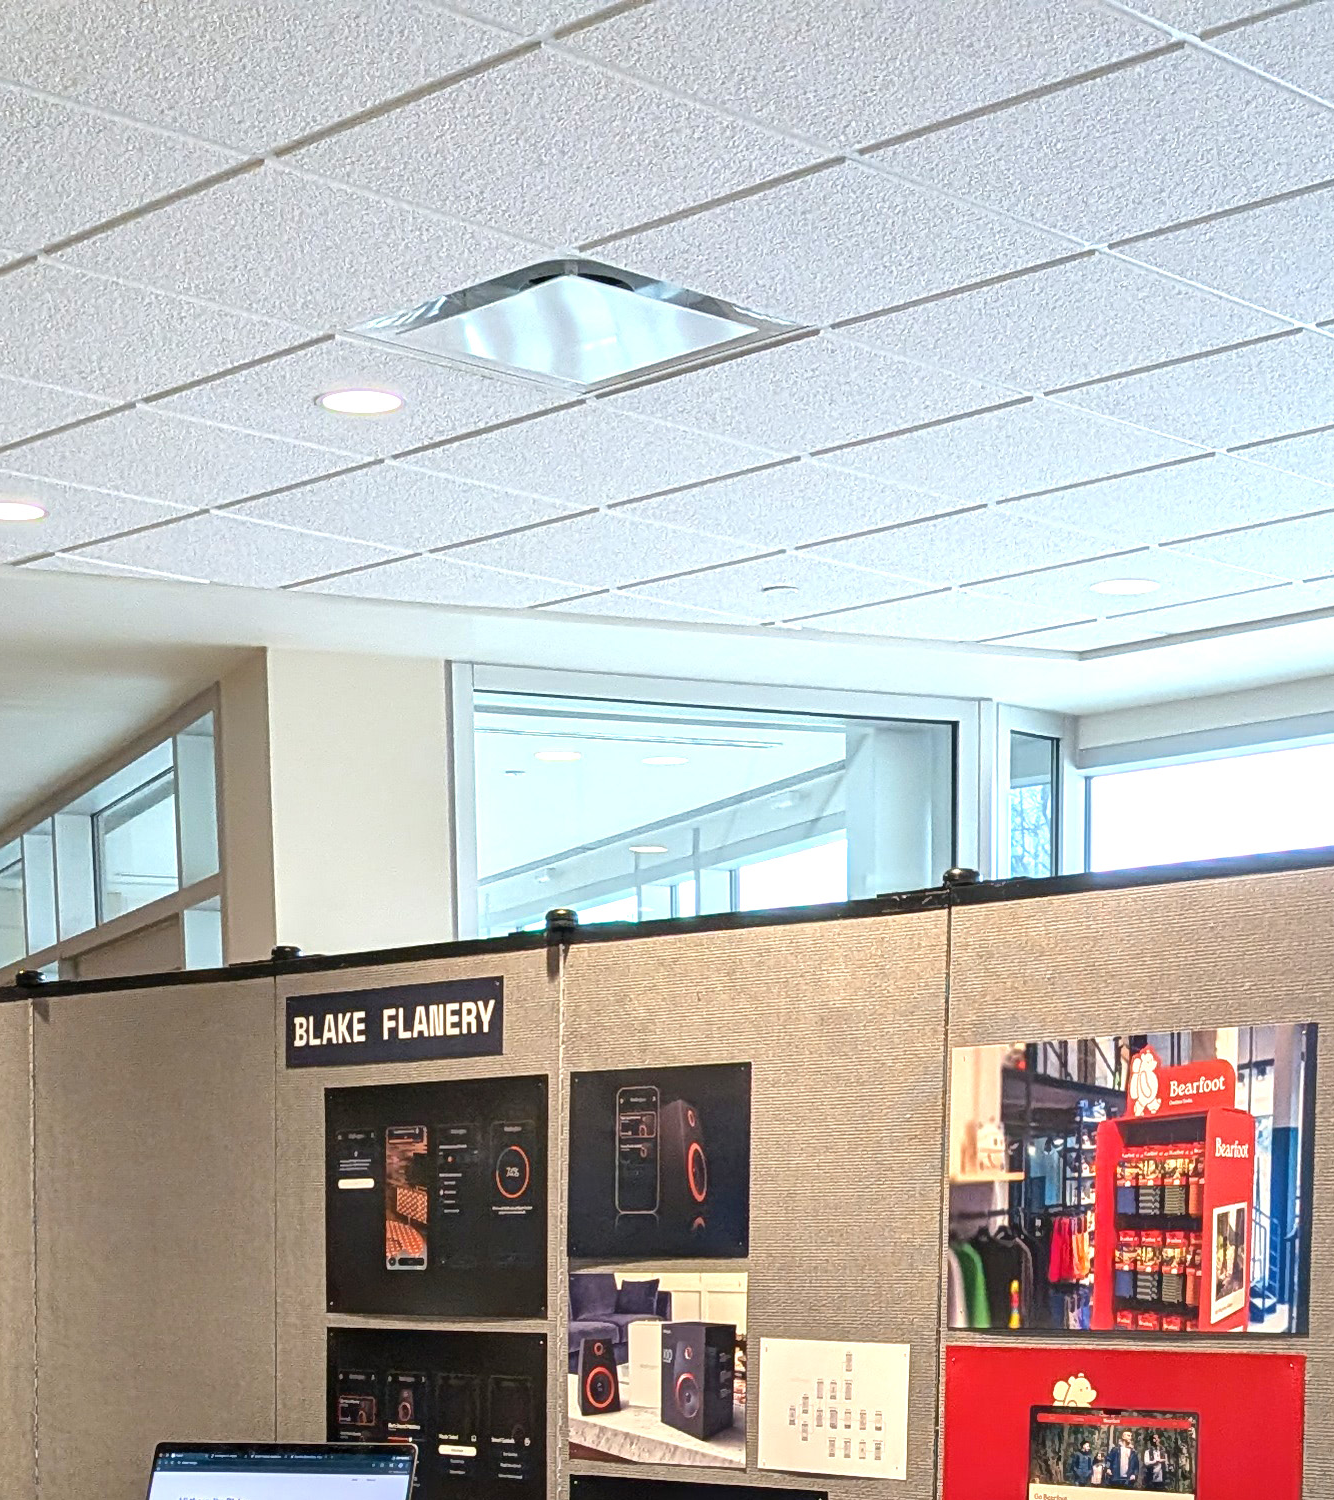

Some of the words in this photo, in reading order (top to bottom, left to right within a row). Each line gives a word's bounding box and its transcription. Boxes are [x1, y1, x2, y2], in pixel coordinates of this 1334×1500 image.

[293, 1011, 366, 1047] BLAKE
[382, 999, 496, 1041] FLANERY
[1169, 1075, 1226, 1097] Bearfoot
[1214, 1136, 1249, 1159] Bearfoot
